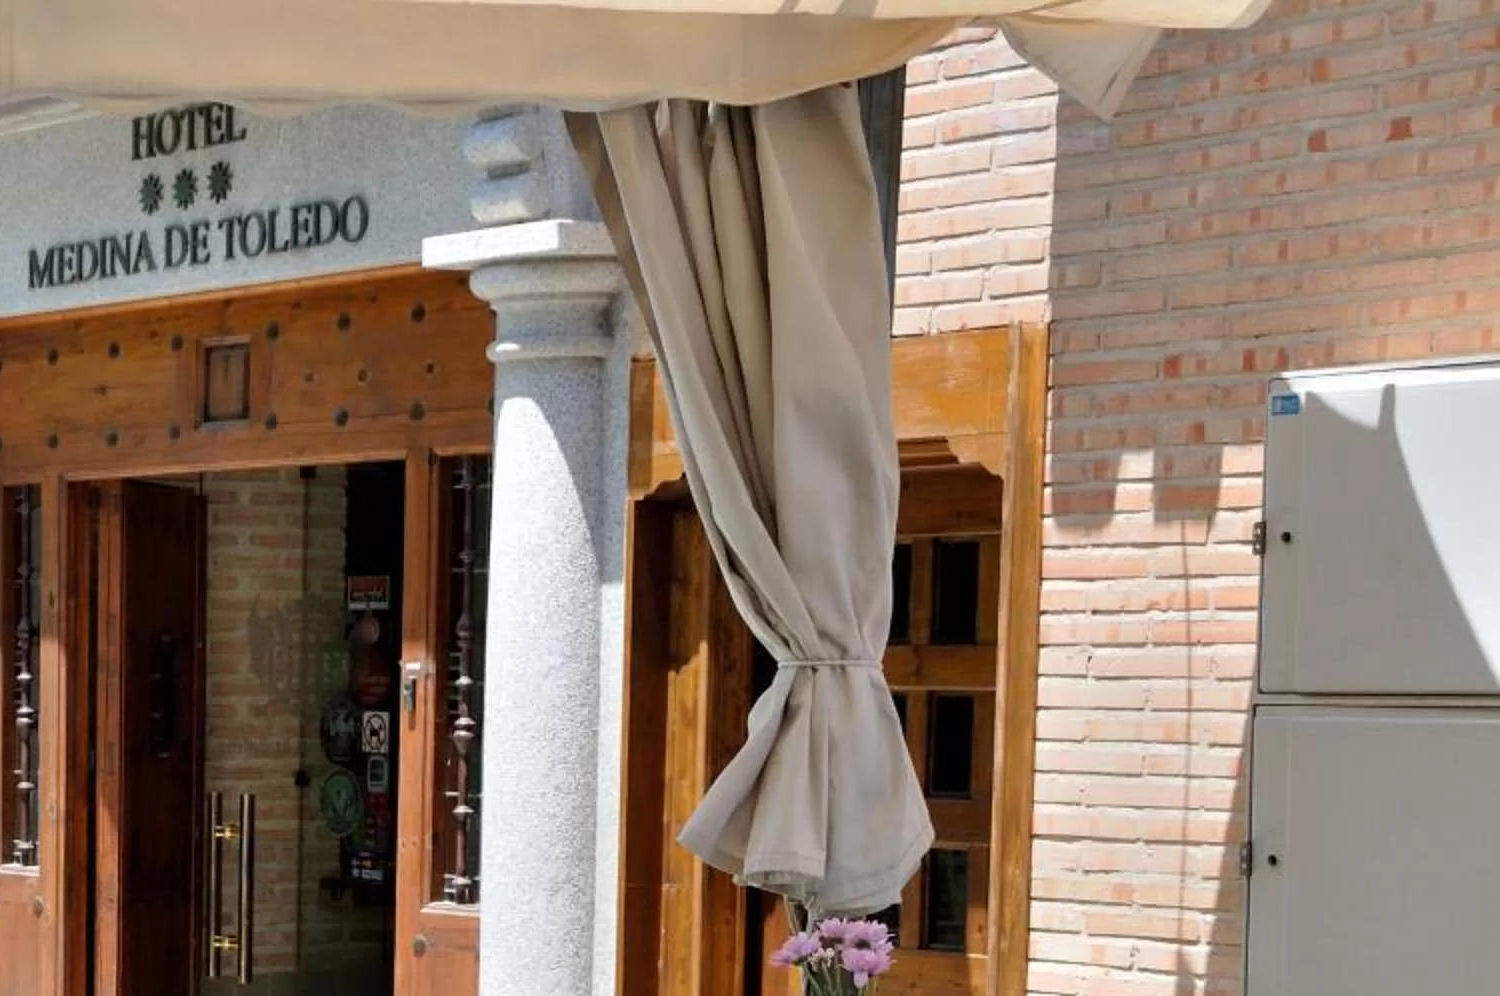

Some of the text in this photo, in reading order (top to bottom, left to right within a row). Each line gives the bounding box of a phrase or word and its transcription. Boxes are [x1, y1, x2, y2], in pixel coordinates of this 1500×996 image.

[132, 101, 247, 160] HOTEL
[28, 195, 370, 289] MEDINA DE TOLEDO
